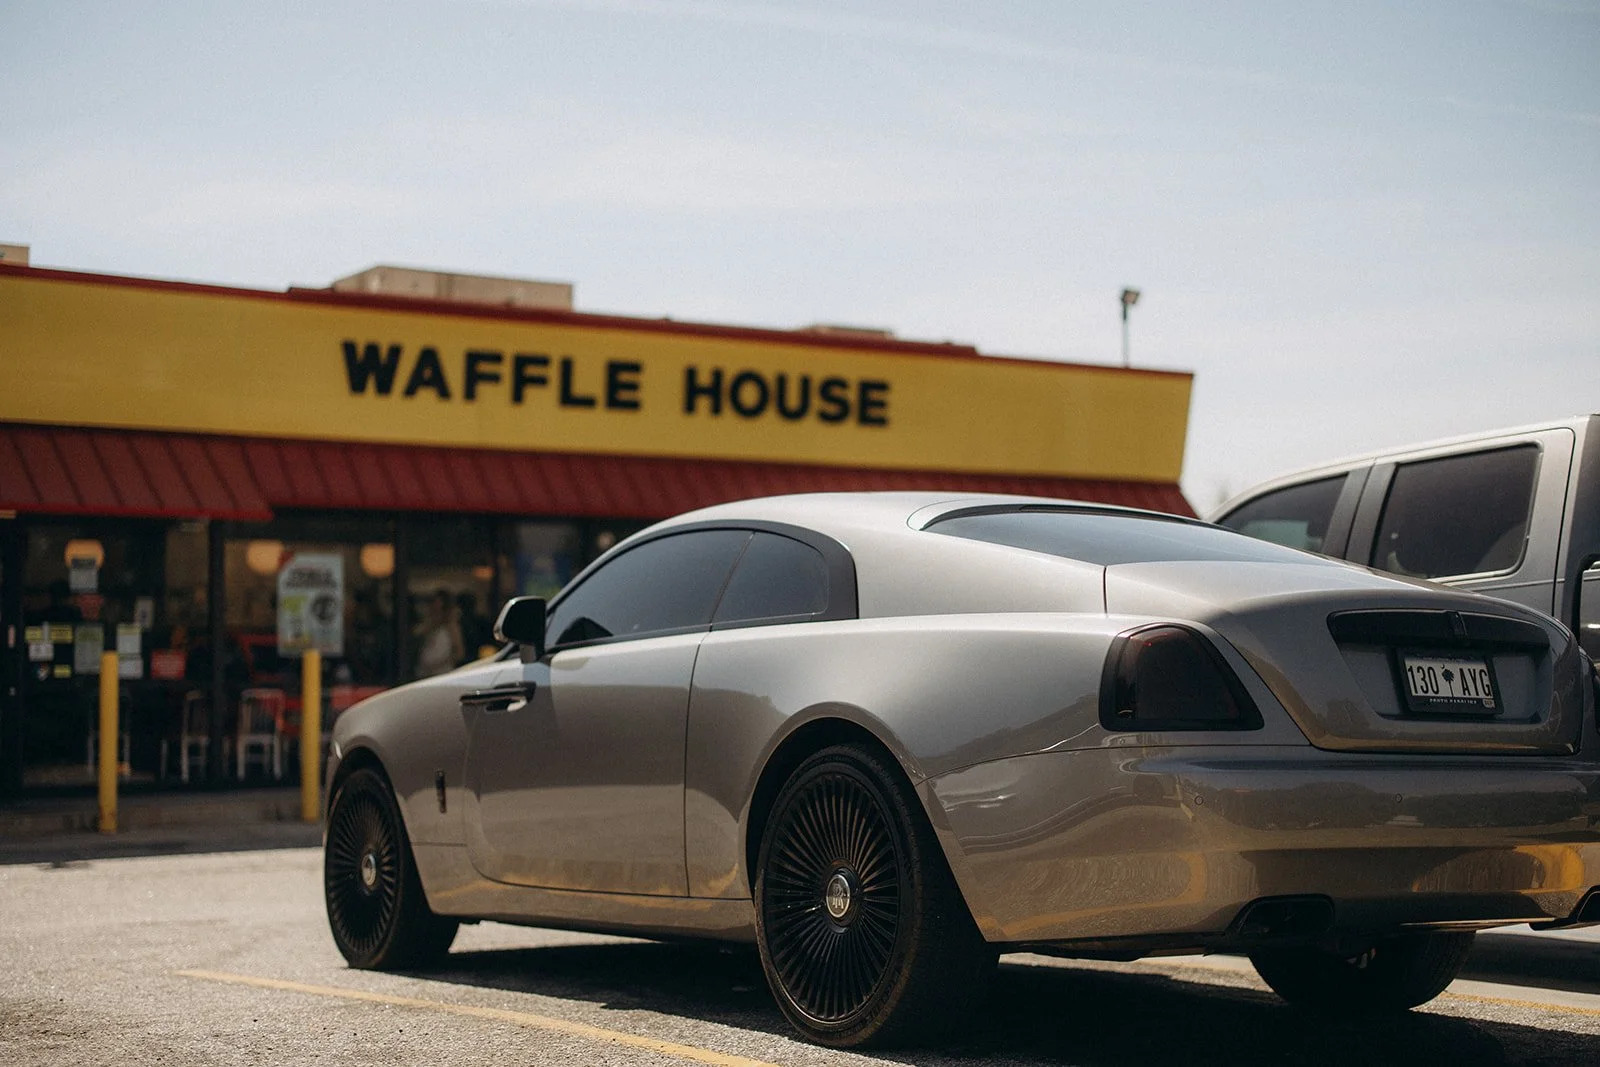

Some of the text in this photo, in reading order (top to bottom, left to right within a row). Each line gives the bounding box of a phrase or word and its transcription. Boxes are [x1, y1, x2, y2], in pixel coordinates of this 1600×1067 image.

[341, 340, 891, 428] WAFFLE HOUSE
[1407, 665, 1492, 697] 130 AYG
